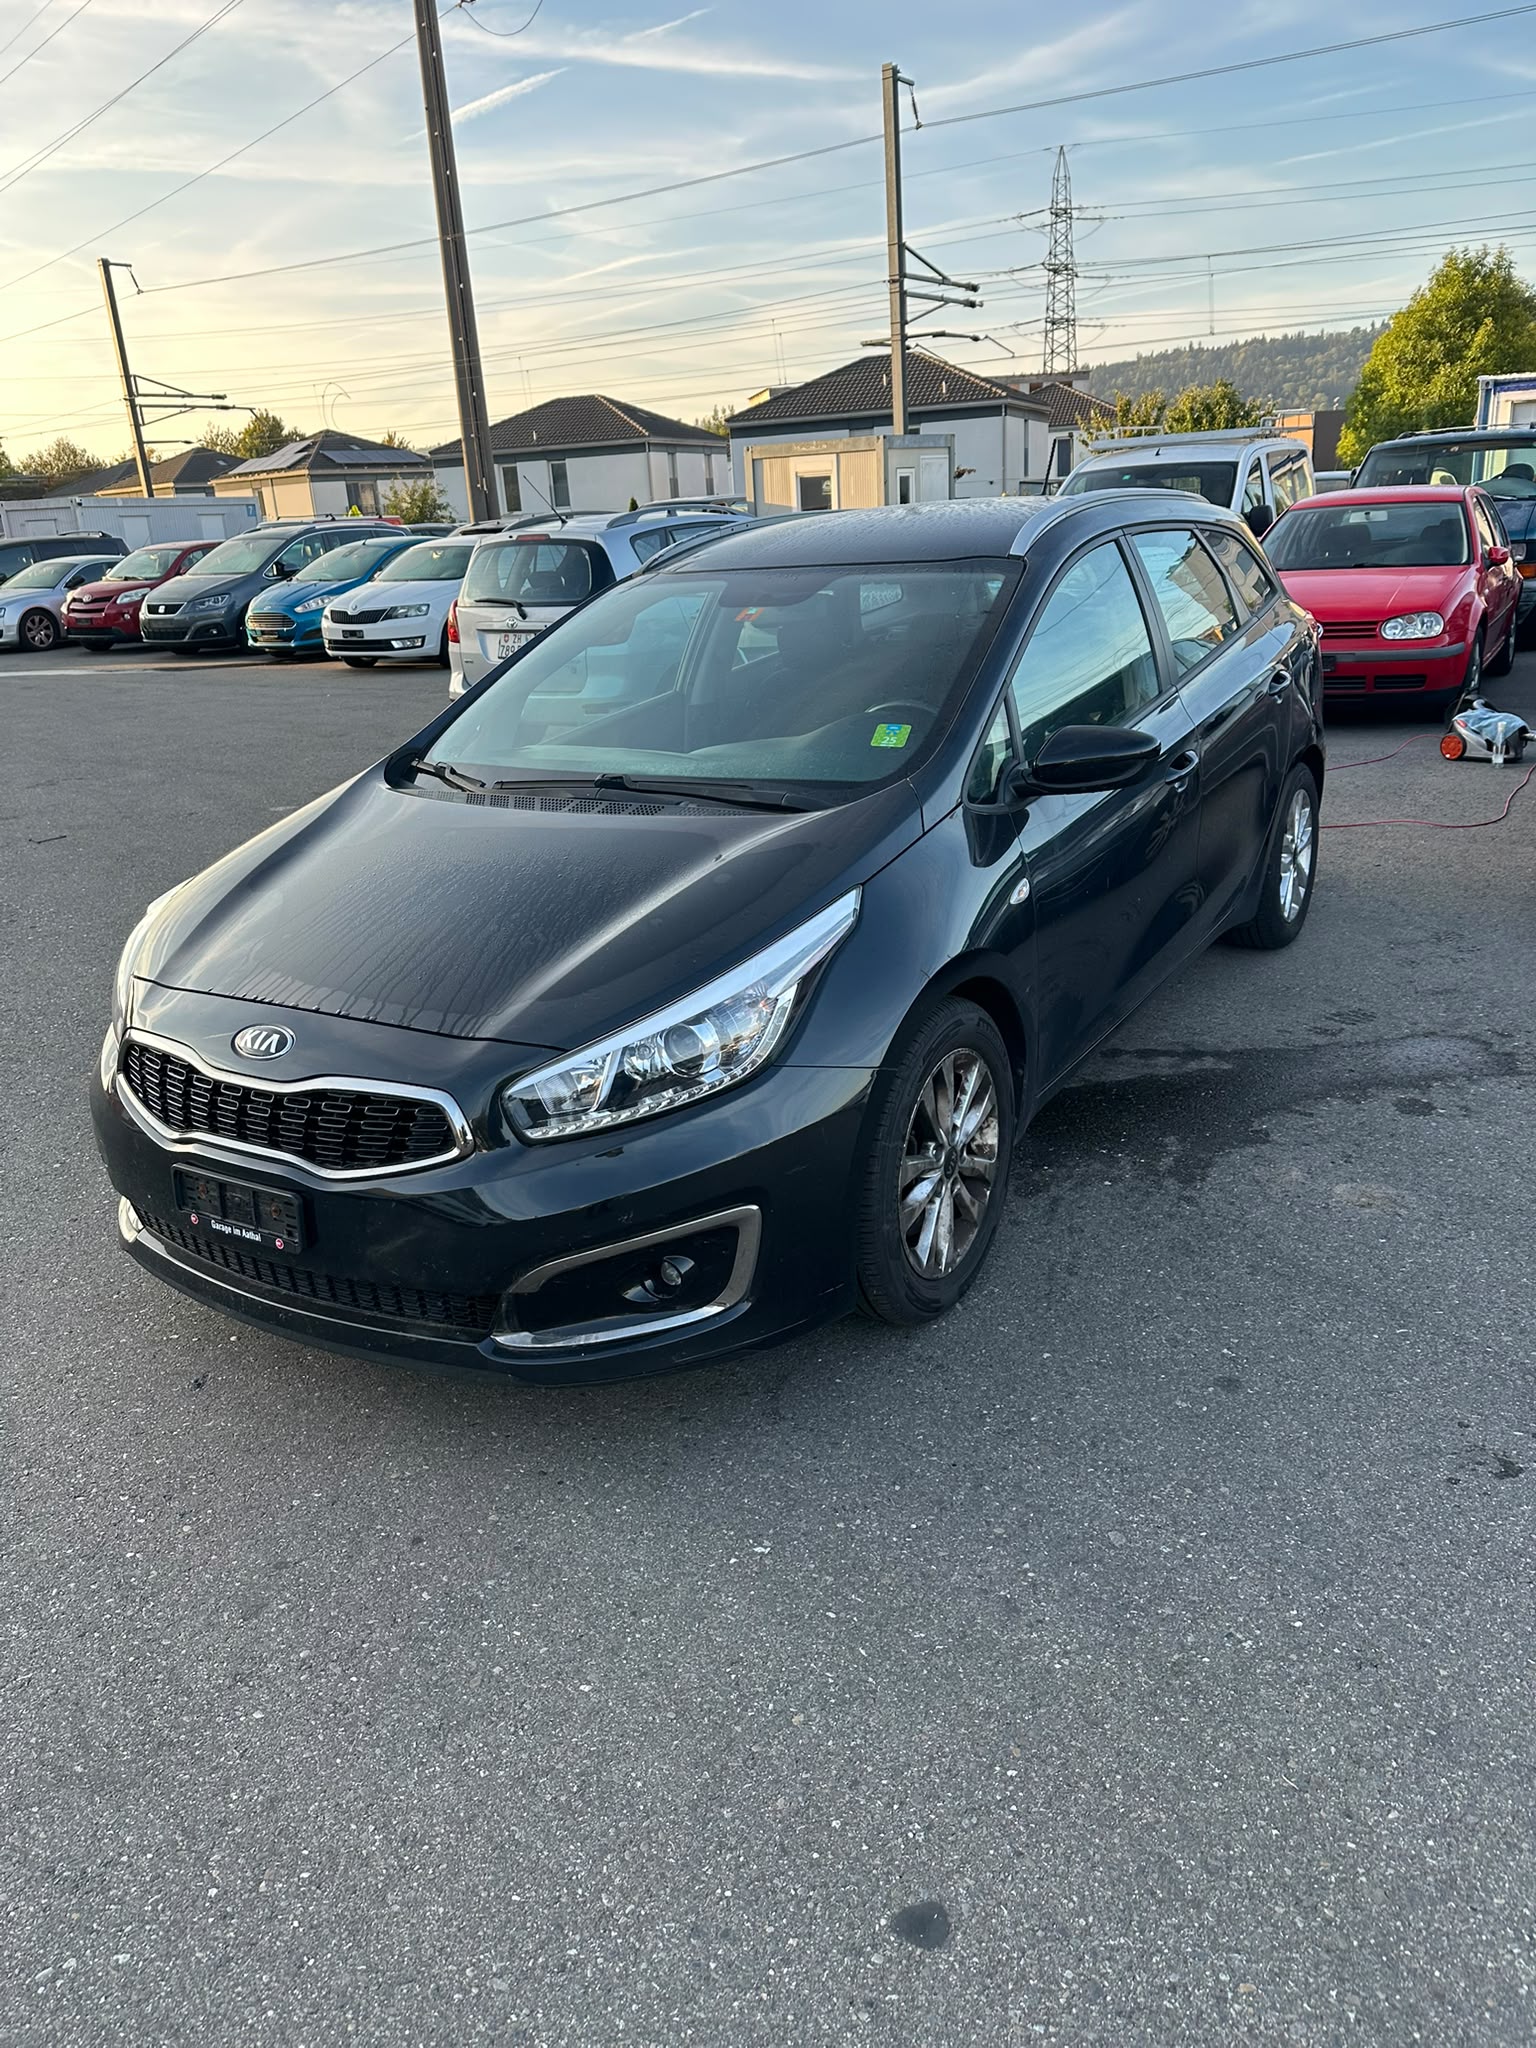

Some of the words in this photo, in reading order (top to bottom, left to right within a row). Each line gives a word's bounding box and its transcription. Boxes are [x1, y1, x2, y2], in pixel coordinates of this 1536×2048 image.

[513, 634, 522, 643] ZH
[881, 736, 897, 744] 25
[240, 1029, 280, 1053] KIA
[211, 1219, 232, 1234] Garage
[232, 1226, 241, 1236] im
